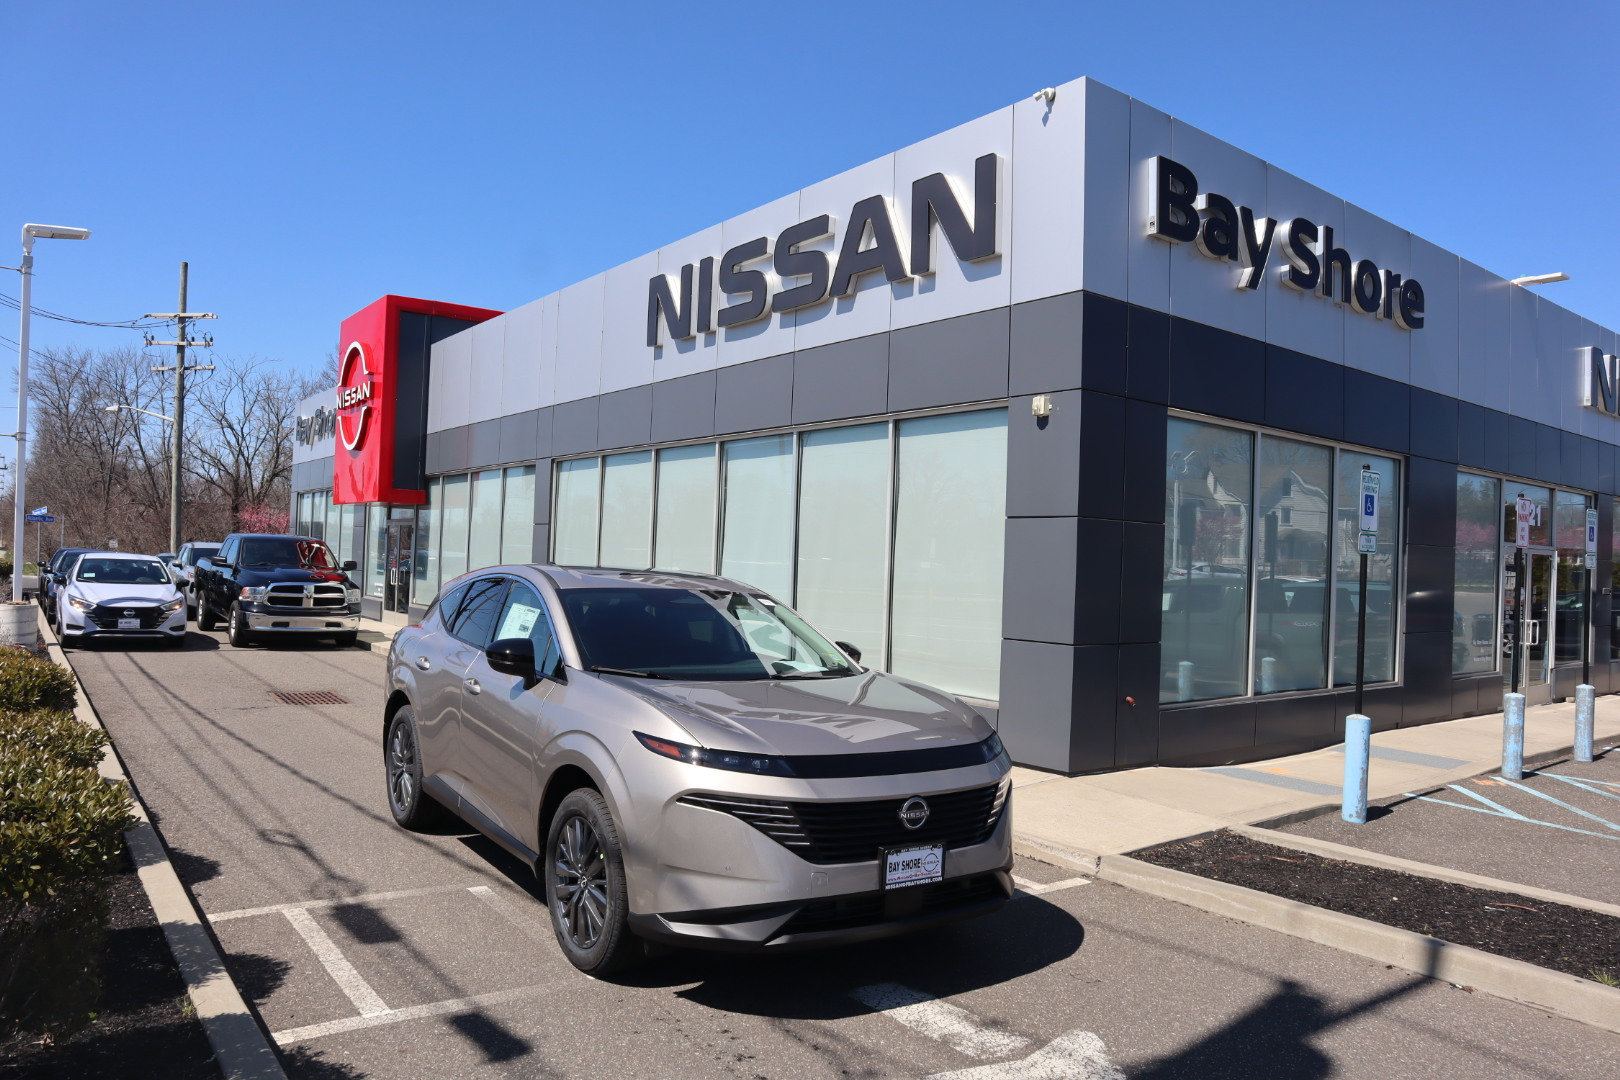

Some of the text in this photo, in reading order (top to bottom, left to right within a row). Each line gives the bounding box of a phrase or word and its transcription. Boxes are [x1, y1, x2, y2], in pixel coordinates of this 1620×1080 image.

[646, 152, 1001, 348] NISSAN
[1148, 155, 1425, 330] Bay Shore
[337, 380, 371, 409] NISSAN
[1584, 346, 1620, 417] N
[296, 405, 337, 445] Bay Shor
[1529, 503, 1541, 526] 21
[900, 809, 930, 819] NISSAN
[888, 860, 900, 873] BAY
[901, 858, 921, 871] SHORE
